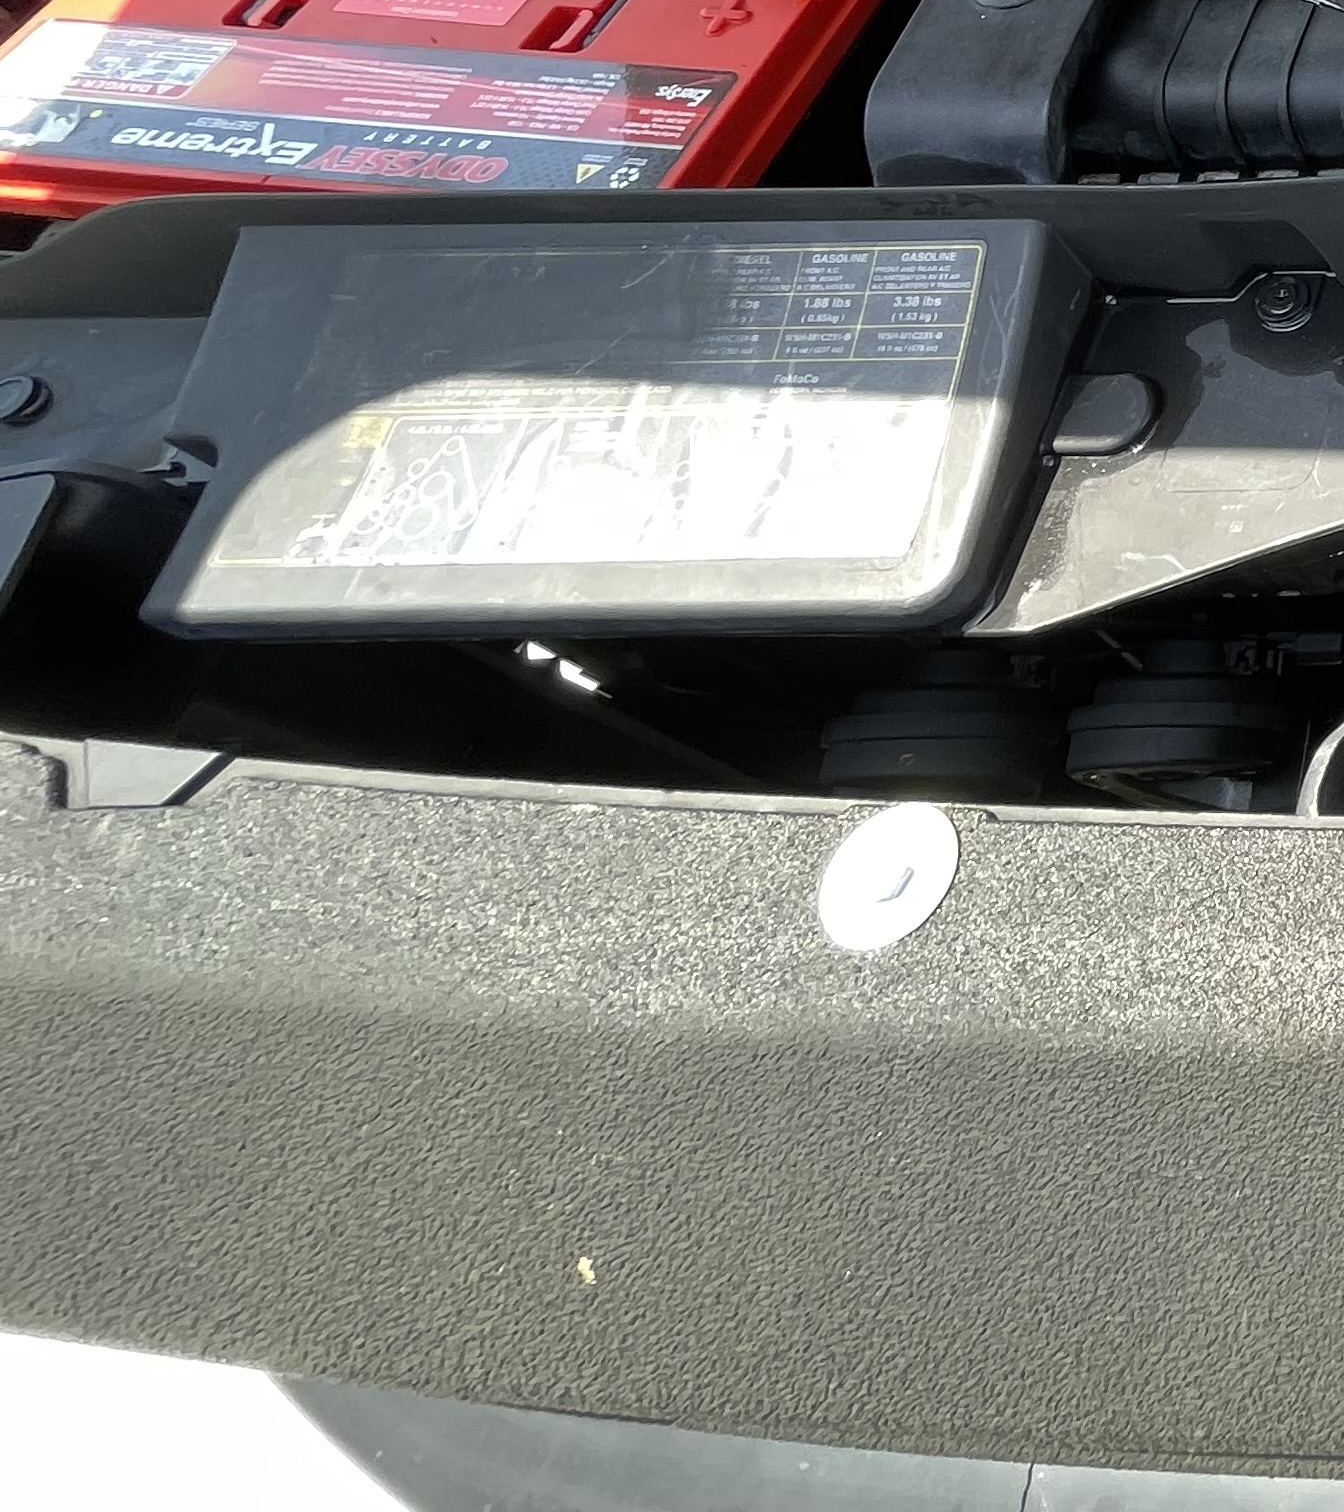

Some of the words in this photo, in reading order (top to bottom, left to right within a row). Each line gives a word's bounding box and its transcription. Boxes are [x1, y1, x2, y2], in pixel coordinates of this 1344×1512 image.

[110, 122, 319, 166] Extreme
[363, 131, 493, 150] BATTERY
[301, 144, 509, 183] ODYSSEY
[812, 253, 870, 264] GASOLINE
[901, 251, 958, 263] GASOLINE
[831, 297, 852, 309] lbs
[922, 295, 942, 307] lbs
[773, 374, 820, 384] FoMoCo
